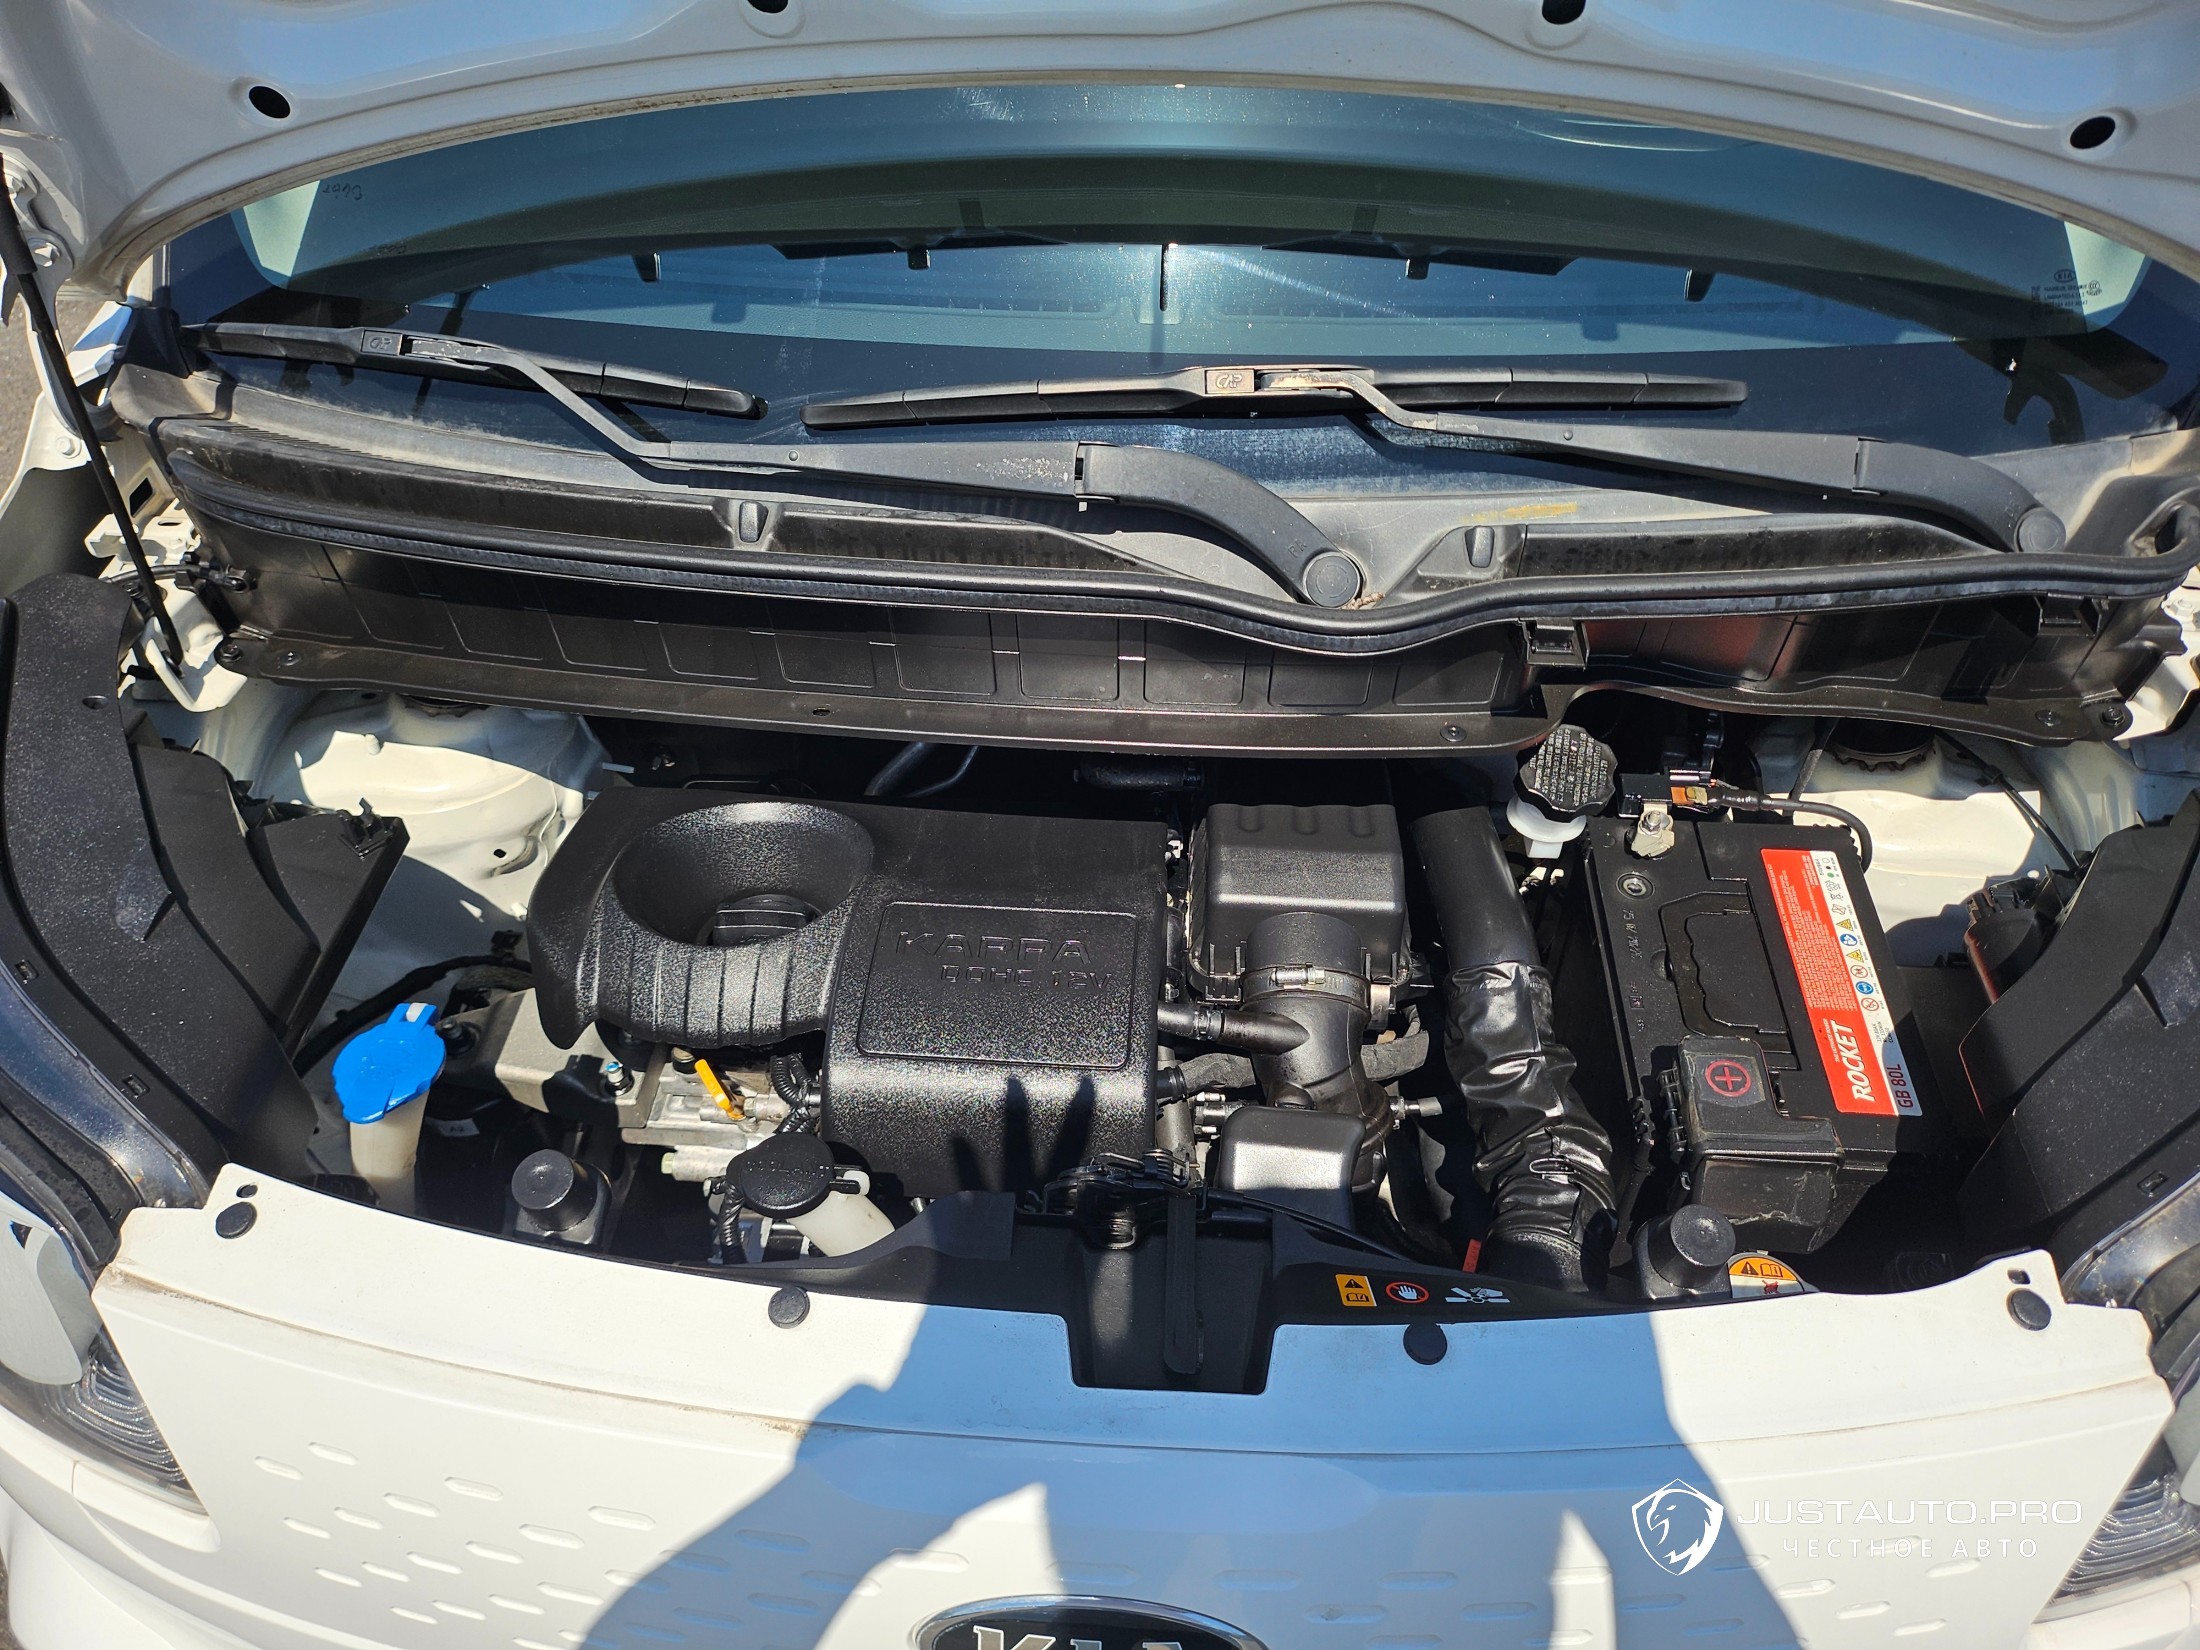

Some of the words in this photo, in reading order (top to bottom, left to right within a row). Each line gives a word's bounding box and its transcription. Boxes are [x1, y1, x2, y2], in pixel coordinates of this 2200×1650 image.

[896, 931, 1091, 964] KAPPA
[1830, 1019, 1876, 1103] ROCKET
[1887, 1063, 1907, 1087] 80L
[1895, 1090, 1913, 1108] GB
